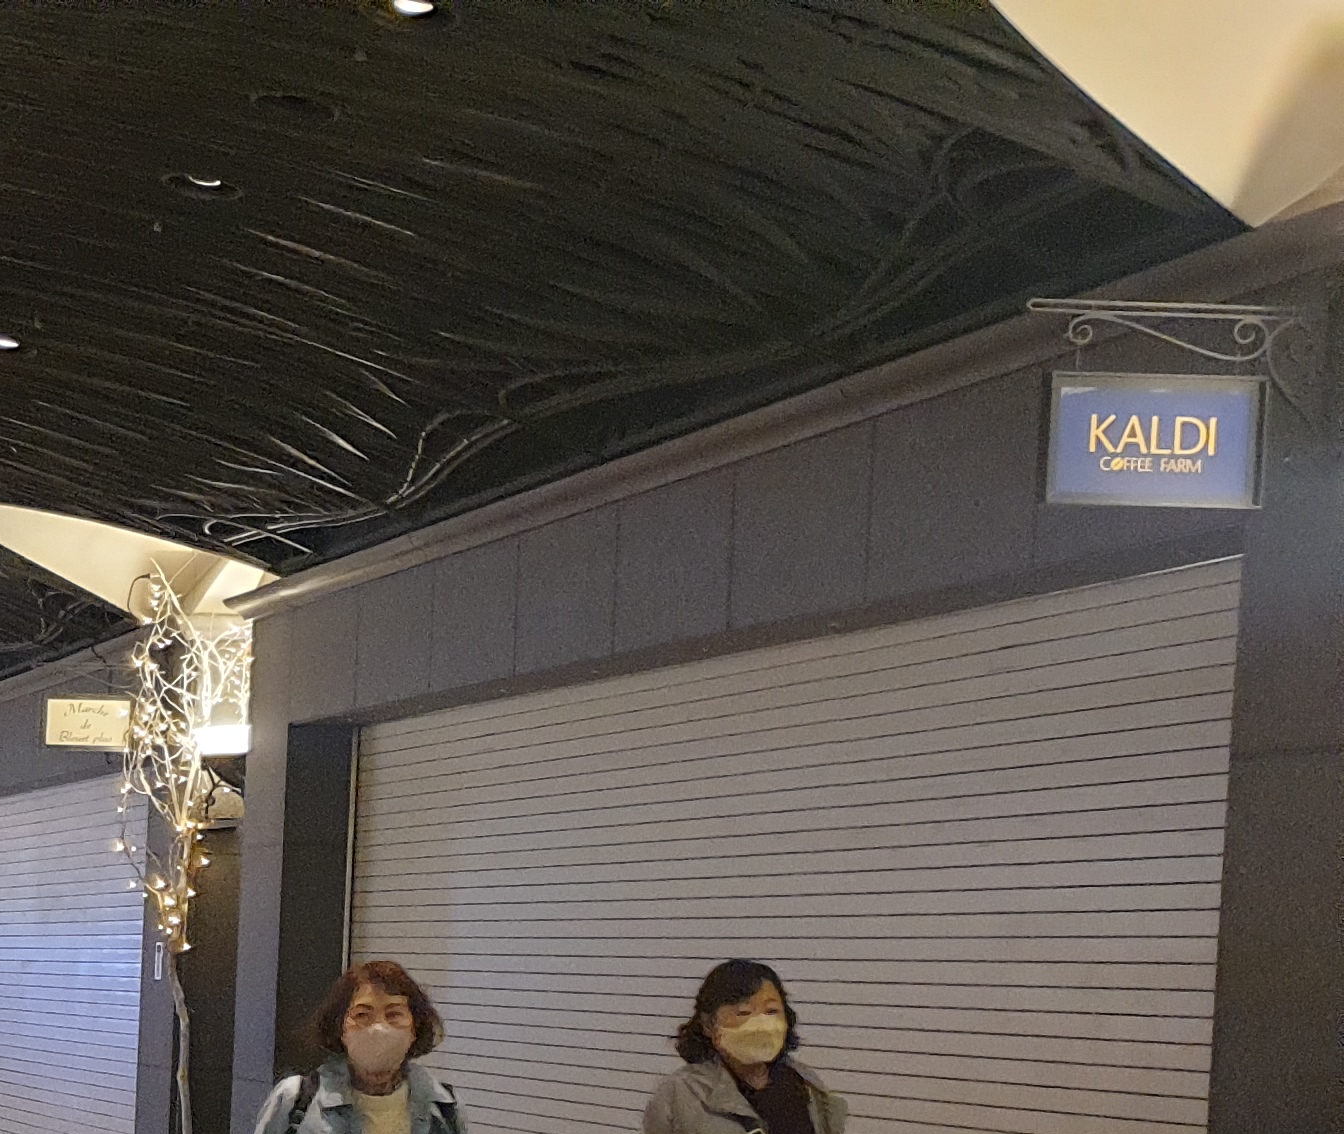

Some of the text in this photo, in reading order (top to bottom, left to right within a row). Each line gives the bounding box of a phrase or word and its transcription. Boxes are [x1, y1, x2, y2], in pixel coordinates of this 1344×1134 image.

[1088, 413, 1218, 456] KALDI
[1099, 456, 1202, 474] COFFEE FARM
